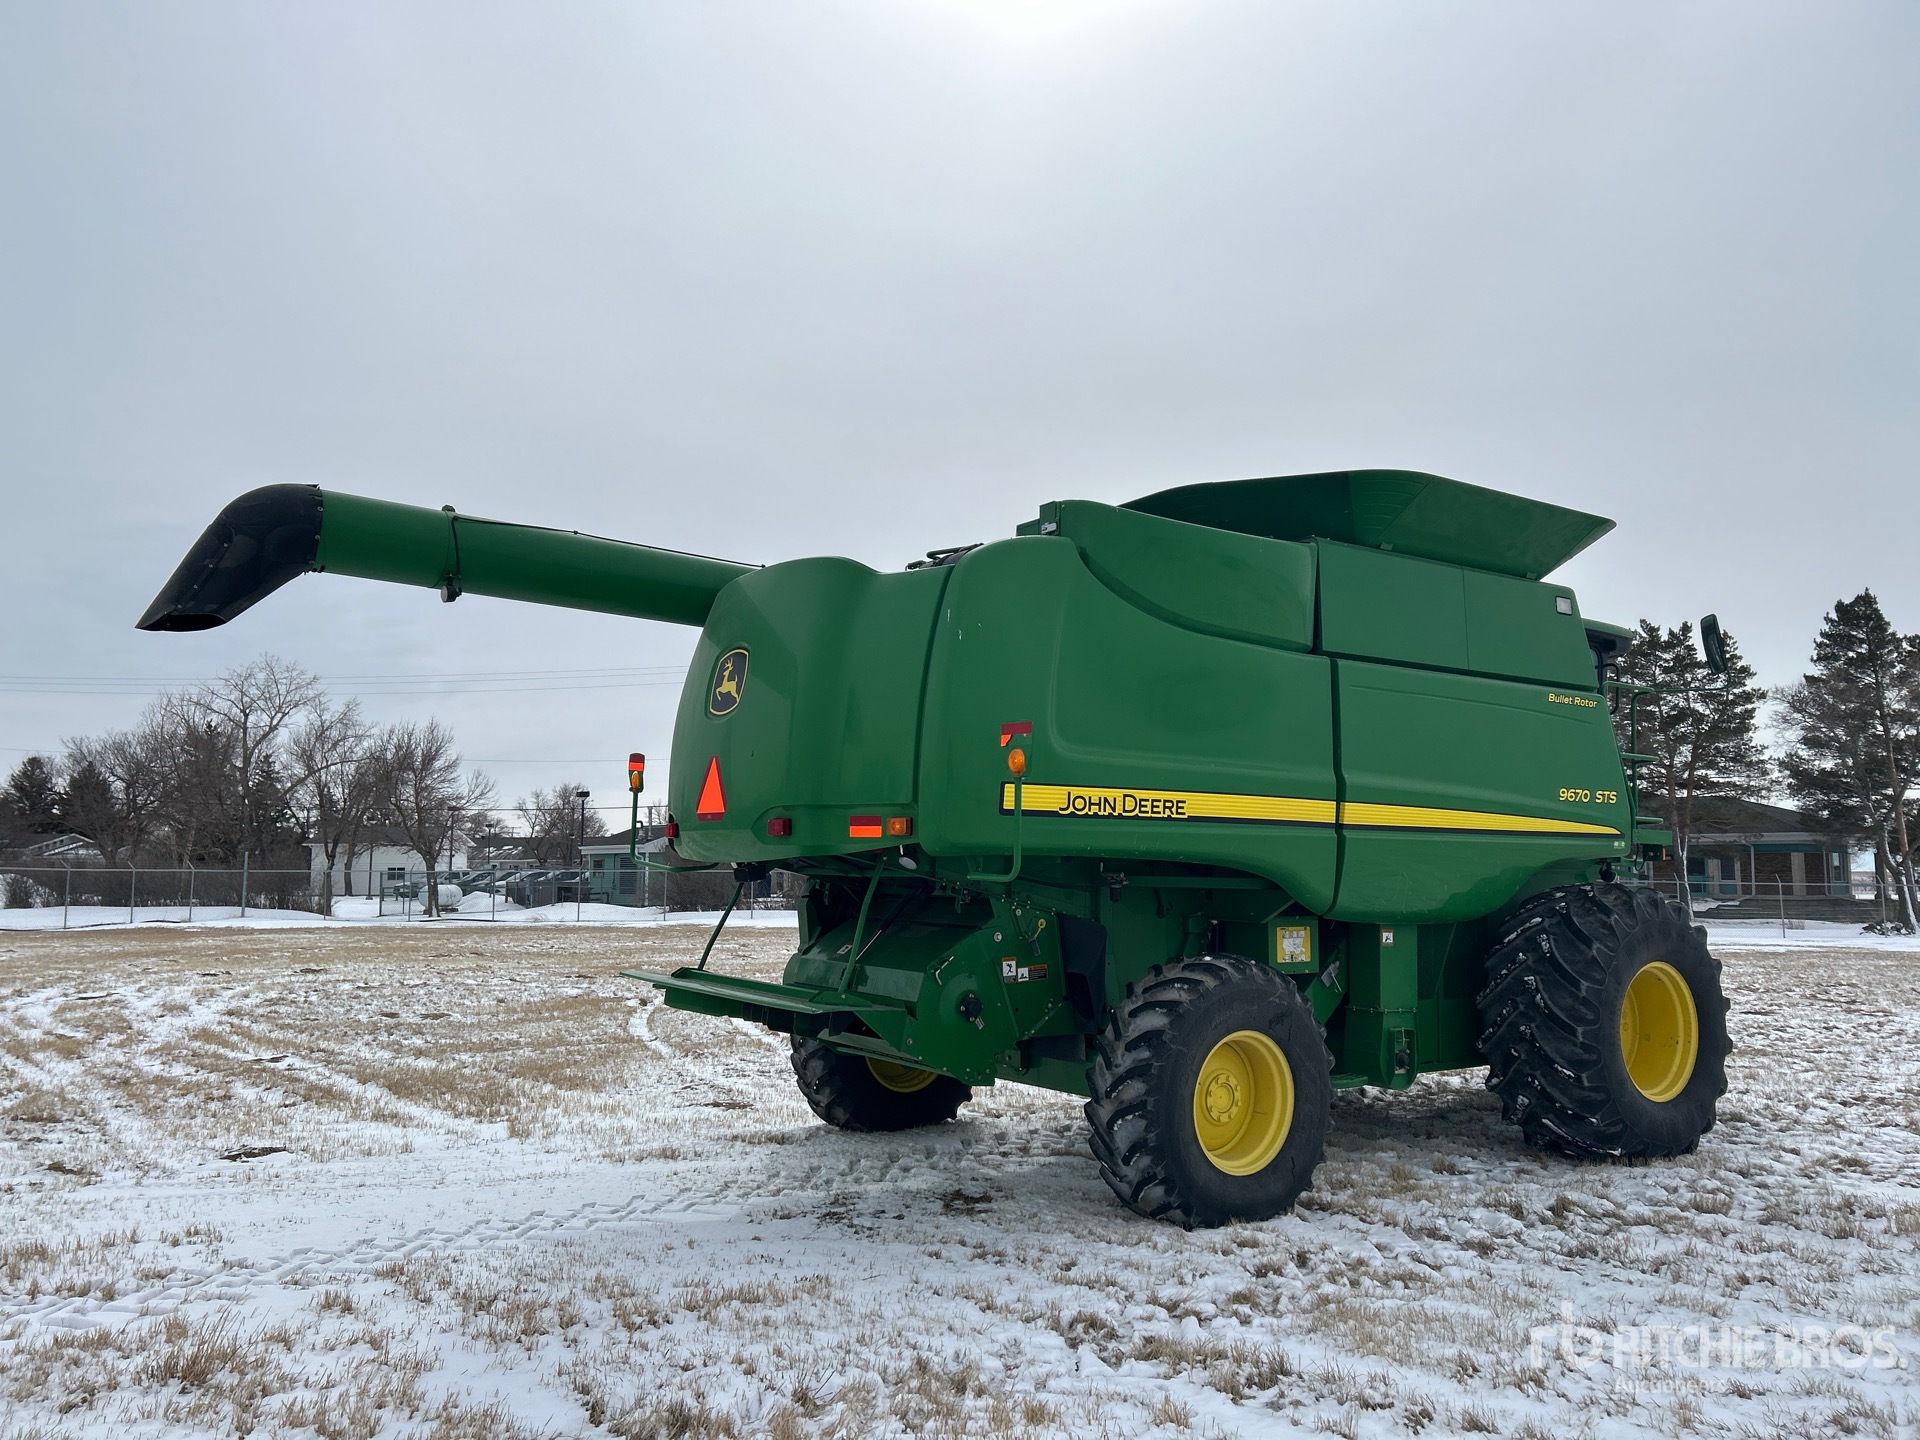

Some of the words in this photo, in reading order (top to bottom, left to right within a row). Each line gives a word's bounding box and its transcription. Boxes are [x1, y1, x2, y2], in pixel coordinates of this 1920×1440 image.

[1548, 693, 1573, 705] Bullet
[1574, 696, 1598, 708] Rotor
[1058, 791, 1117, 814] JOHN
[1122, 793, 1188, 817] DEERE
[1559, 788, 1591, 802] 9670
[1595, 791, 1617, 804] STS
